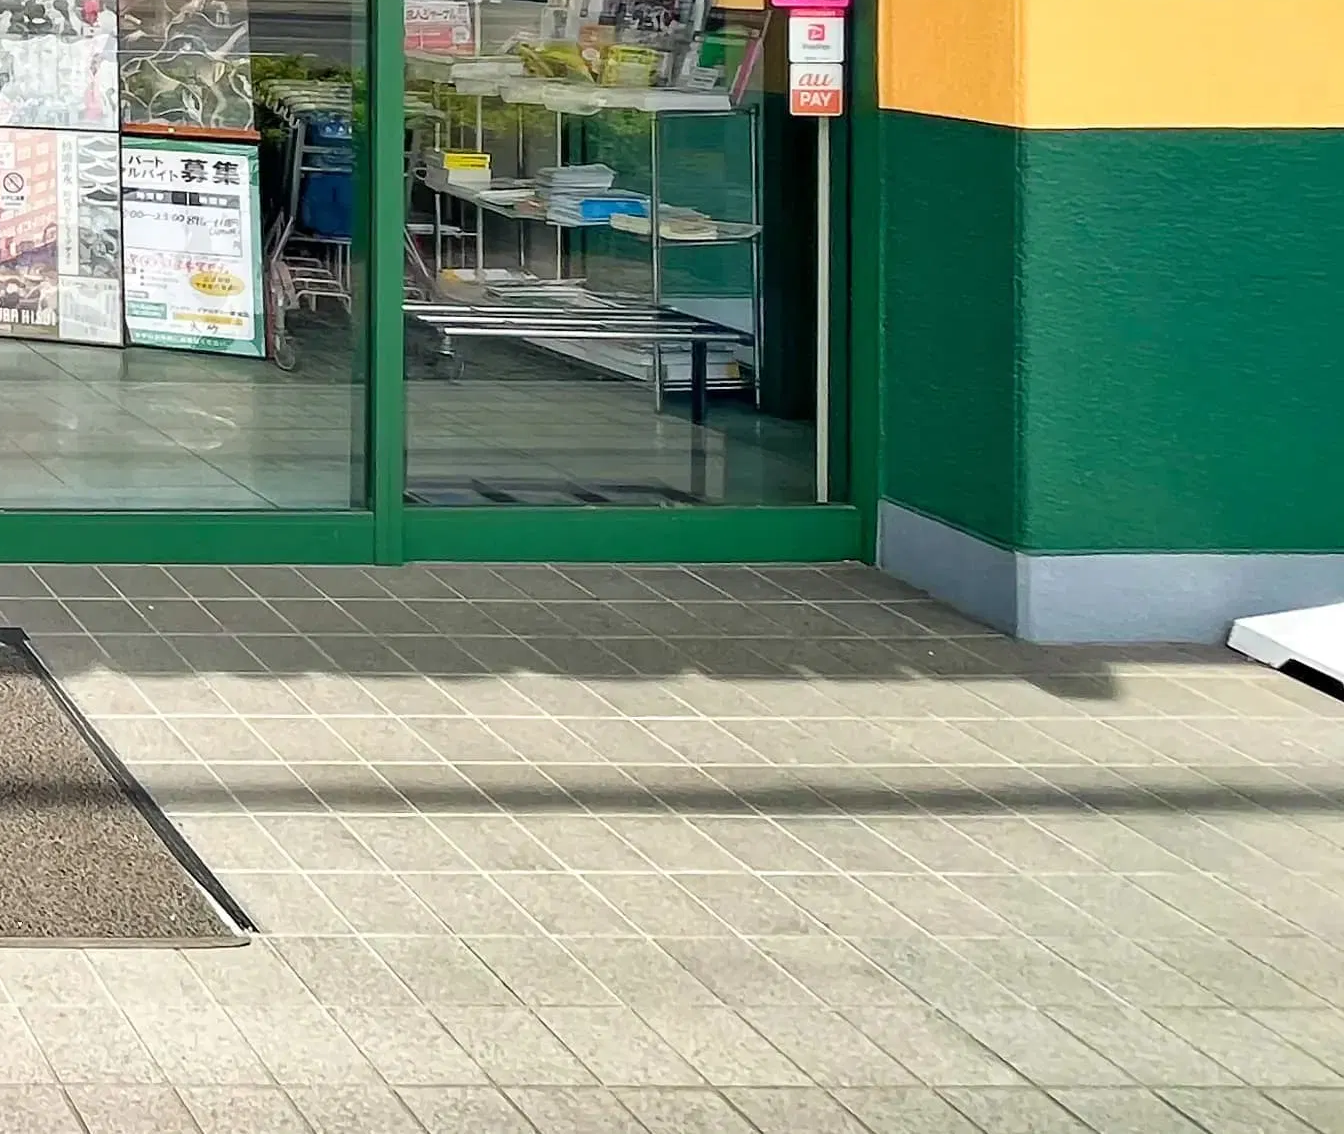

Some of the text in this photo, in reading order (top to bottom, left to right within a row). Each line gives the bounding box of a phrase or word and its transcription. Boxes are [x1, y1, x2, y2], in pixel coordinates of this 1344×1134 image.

[799, 73, 833, 87] au
[799, 92, 832, 107] PAY
[180, 158, 240, 185] 募集
